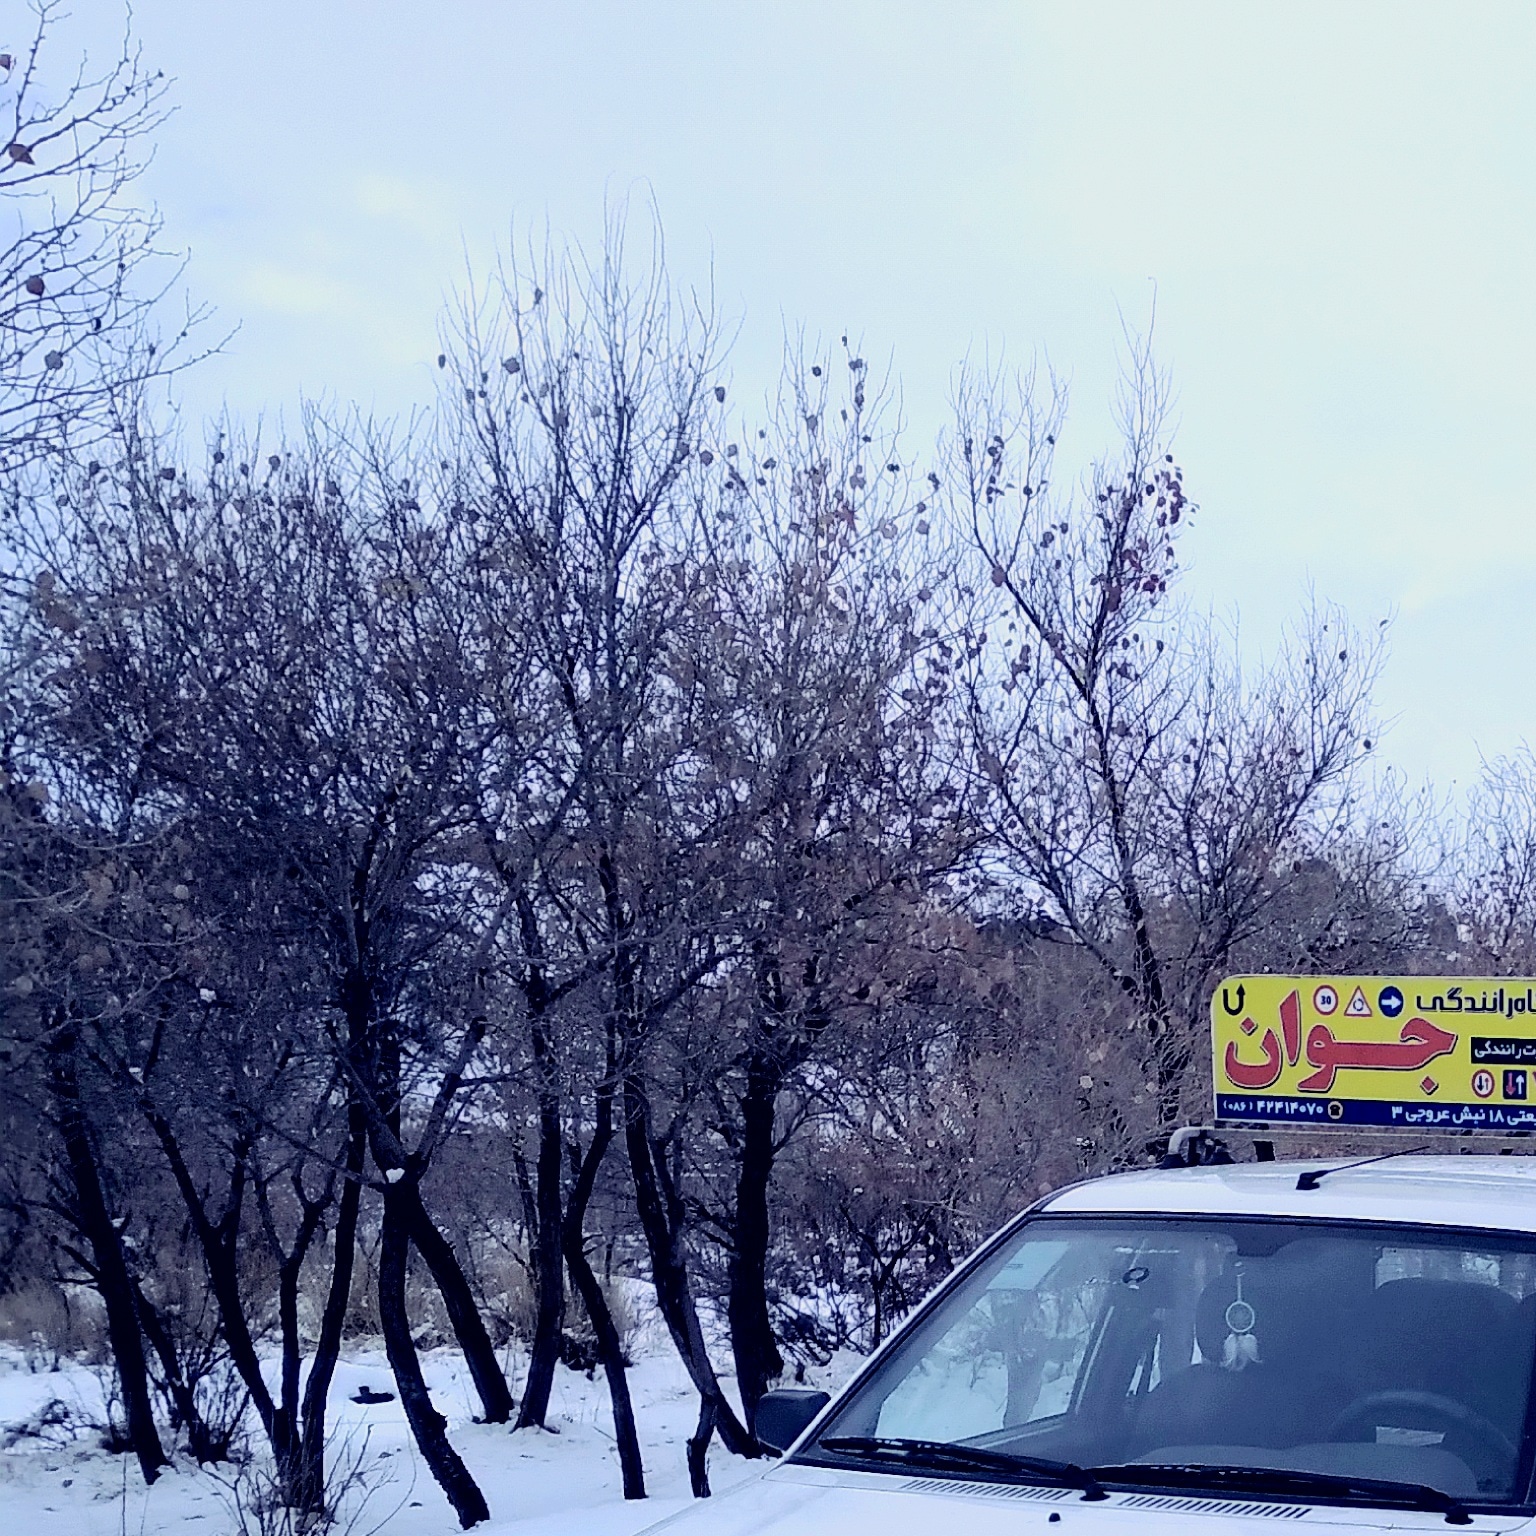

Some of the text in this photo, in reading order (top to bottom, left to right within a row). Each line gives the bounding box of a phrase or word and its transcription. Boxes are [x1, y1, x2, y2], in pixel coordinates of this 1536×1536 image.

[1320, 996, 1332, 1006] 30
[1416, 987, 1513, 1020] رانندگی
[1224, 988, 1459, 1095] جوان
[1474, 1040, 1522, 1059] رانندگی
[1391, 1106, 1403, 1120] ۳
[1405, 1107, 1450, 1124] عروجی
[1452, 1106, 1486, 1126] نبش
[1489, 1109, 1505, 1123] ۱۸
